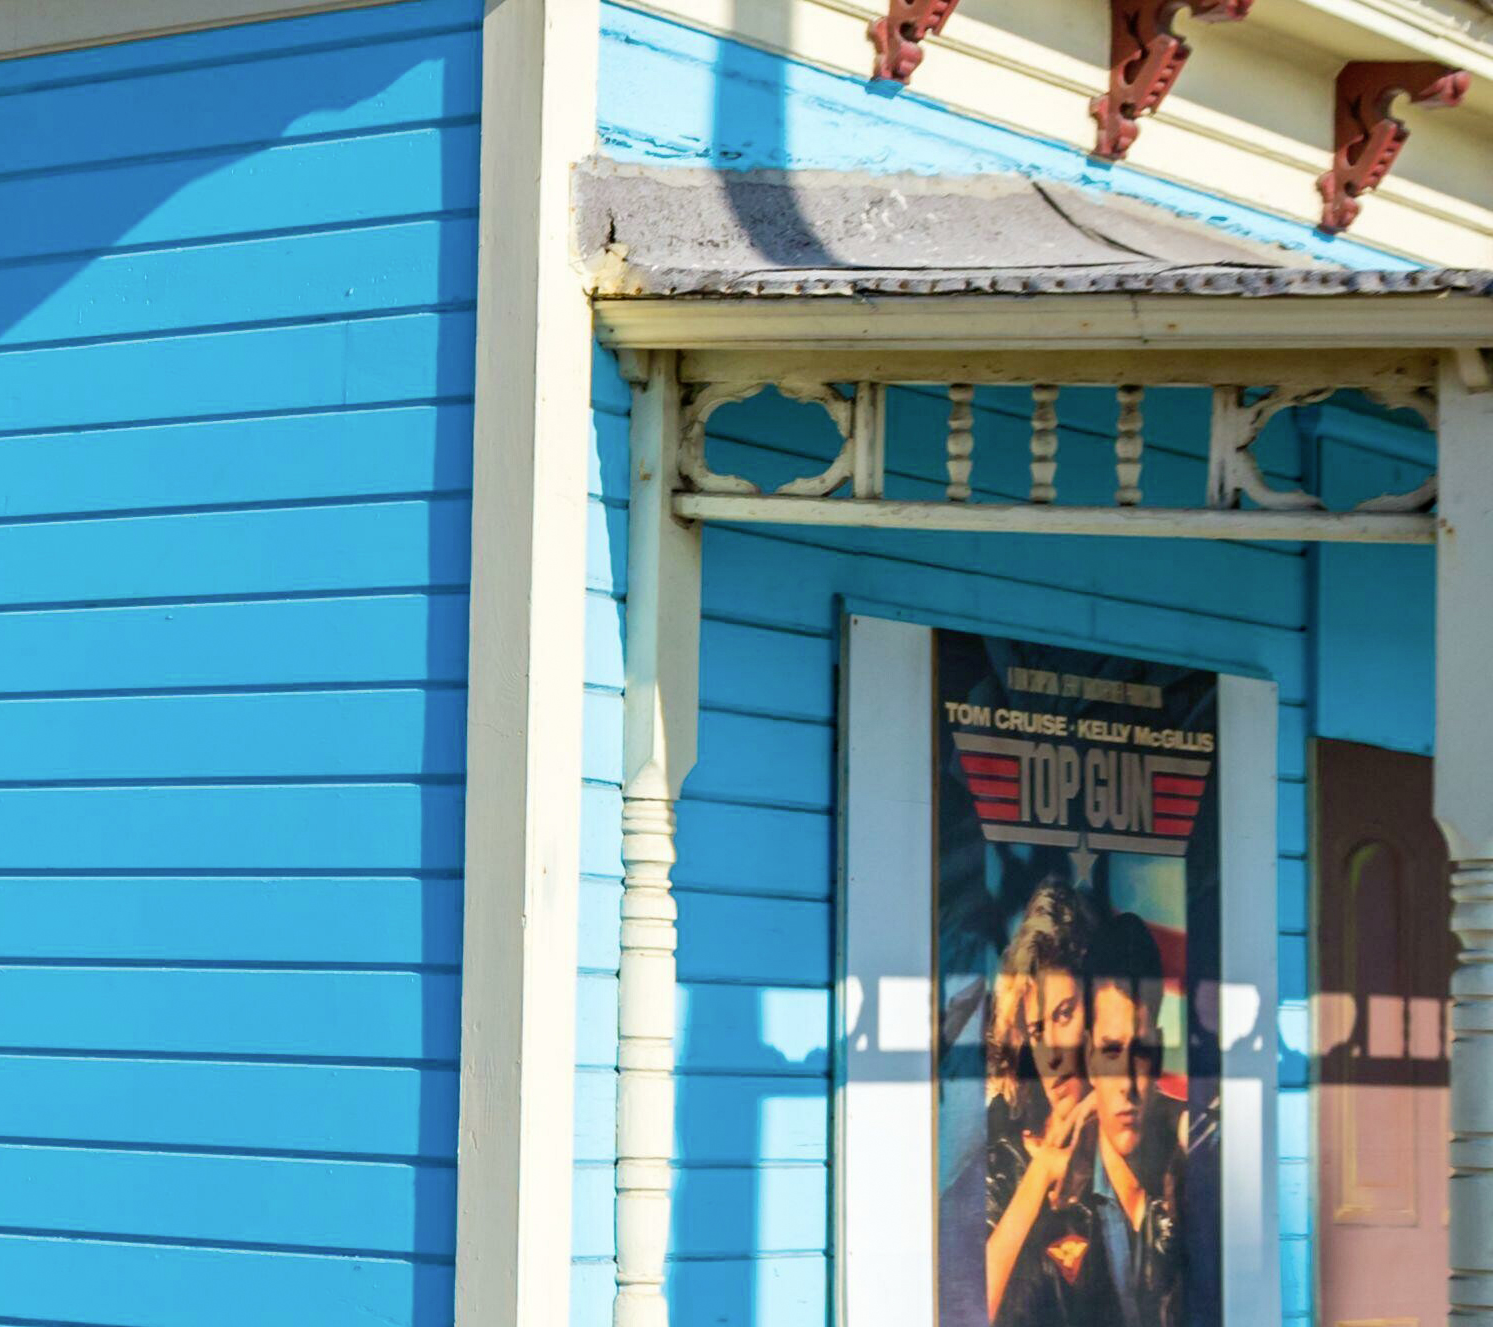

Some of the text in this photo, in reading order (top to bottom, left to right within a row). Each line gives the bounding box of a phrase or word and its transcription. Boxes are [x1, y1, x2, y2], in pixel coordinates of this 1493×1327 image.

[945, 701, 1214, 753] TOM CRUISE KELLY McGILLIS
[1018, 742, 1154, 832] TOP GUN
